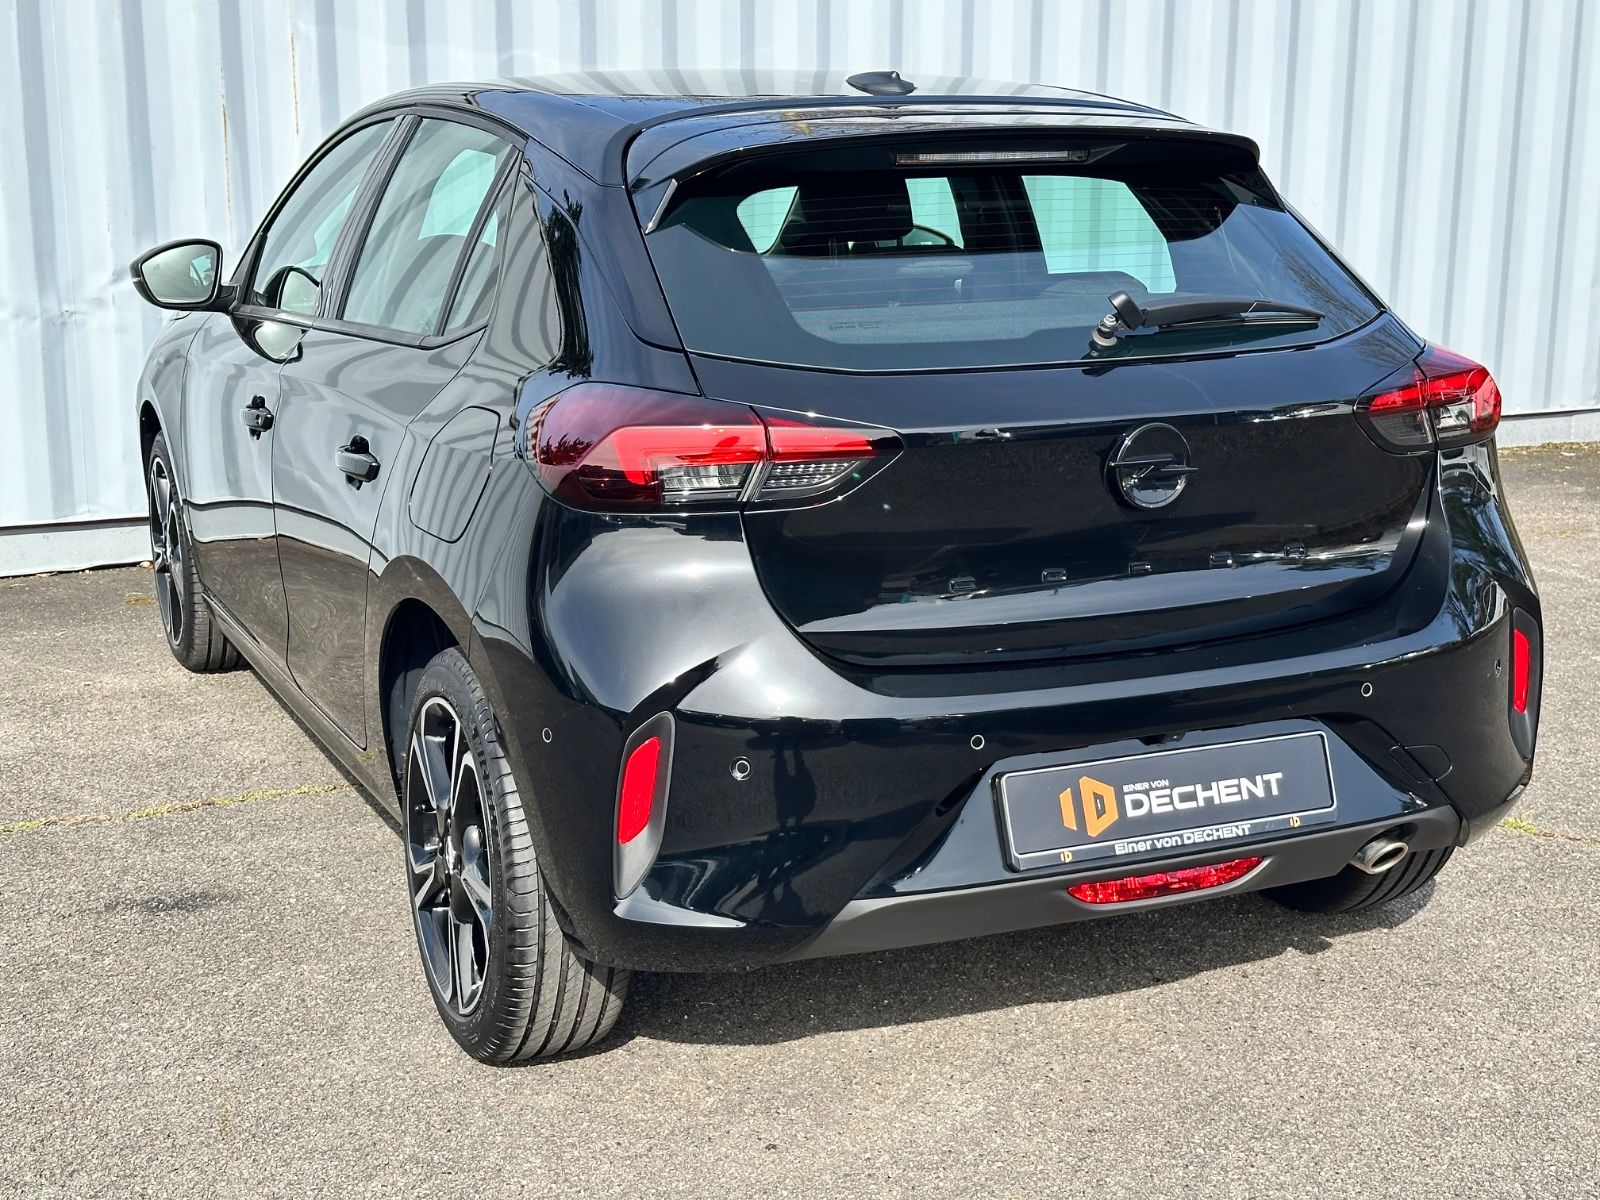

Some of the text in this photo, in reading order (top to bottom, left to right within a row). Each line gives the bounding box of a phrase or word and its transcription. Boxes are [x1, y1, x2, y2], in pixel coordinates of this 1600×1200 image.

[1122, 779, 1169, 793] EINER VON
[1124, 771, 1283, 818] DECHENT
[1114, 823, 1251, 855] Einer von DECHENT
